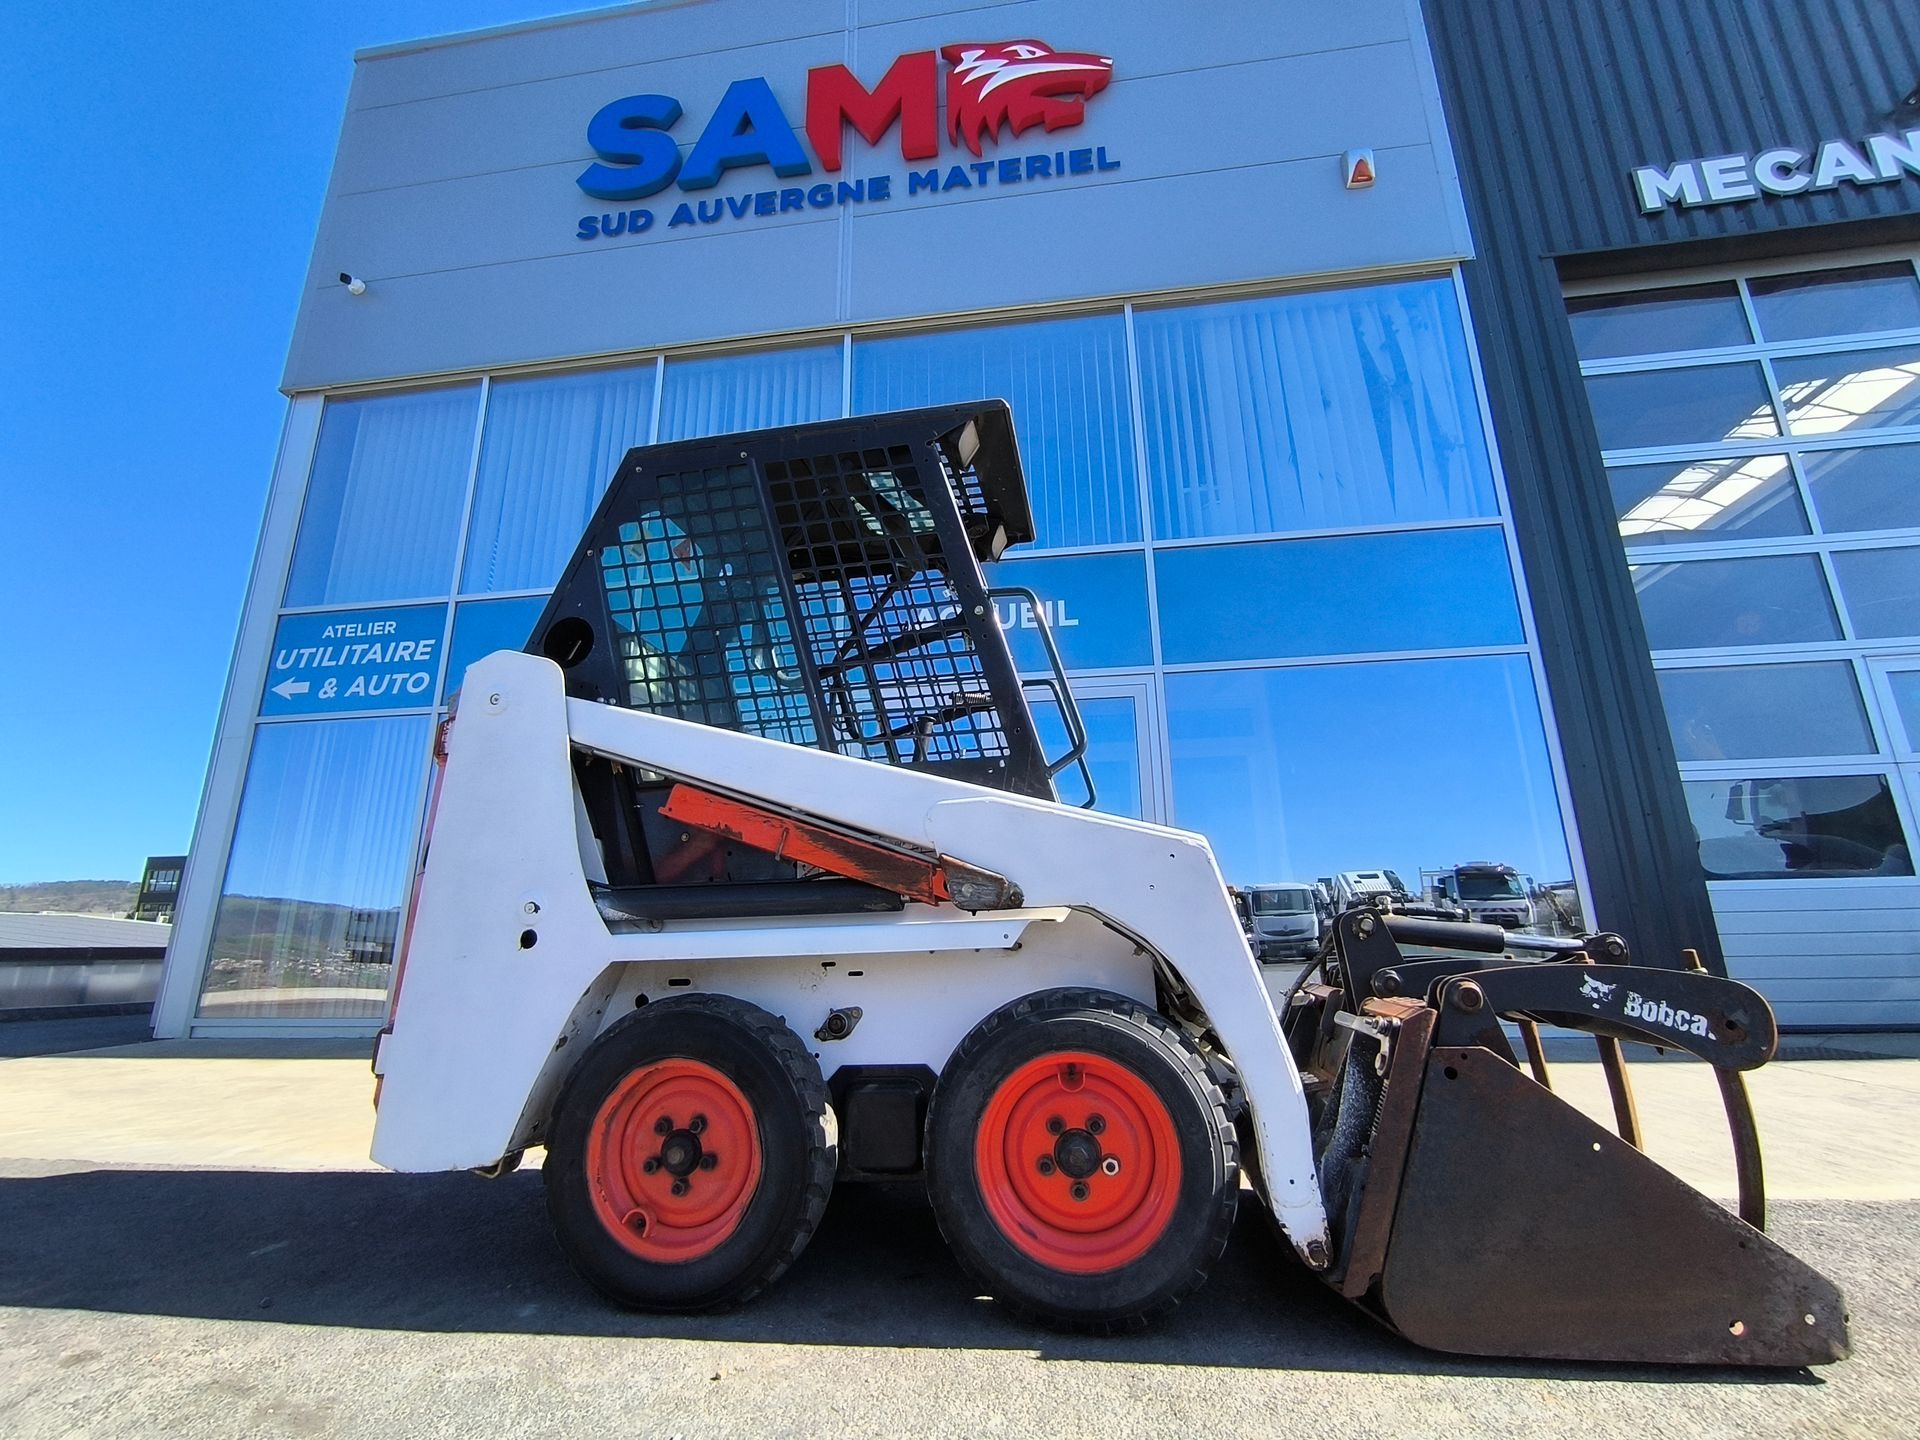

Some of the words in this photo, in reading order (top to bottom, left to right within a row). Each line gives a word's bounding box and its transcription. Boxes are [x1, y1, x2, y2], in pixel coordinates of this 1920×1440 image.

[576, 50, 938, 200] SAM
[576, 208, 653, 240] SUD
[668, 176, 891, 227] AUVERGNE
[908, 146, 1120, 195] MATERIEL
[322, 621, 397, 639] ATELIER
[275, 639, 436, 670] UTILITAIRE
[318, 677, 338, 699] &
[343, 671, 430, 697] AUTO
[1624, 990, 1717, 1041] Bobca
